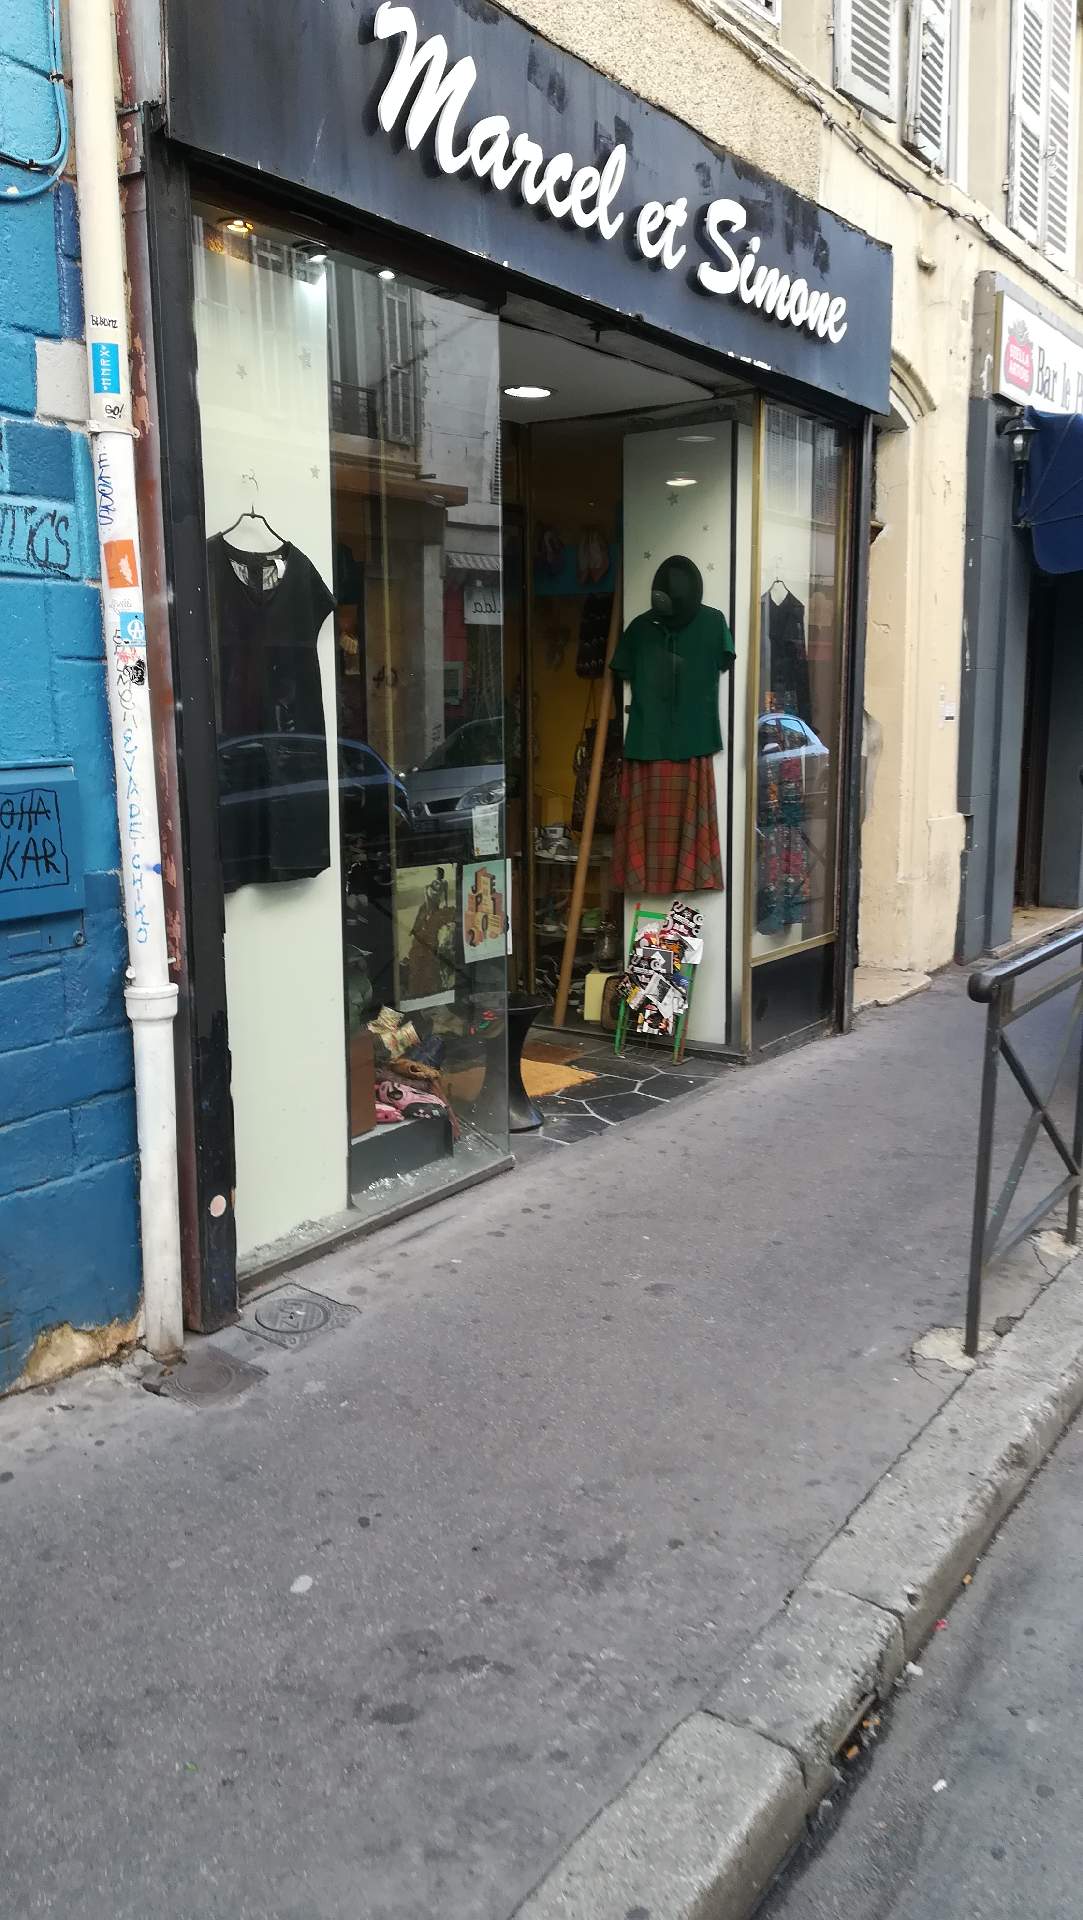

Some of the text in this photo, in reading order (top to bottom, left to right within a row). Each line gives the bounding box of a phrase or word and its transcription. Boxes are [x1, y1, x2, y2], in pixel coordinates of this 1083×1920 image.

[373, 1, 848, 344] Marcel et Simone
[1035, 346, 1058, 402] Bar
[1060, 362, 1071, 411] le
